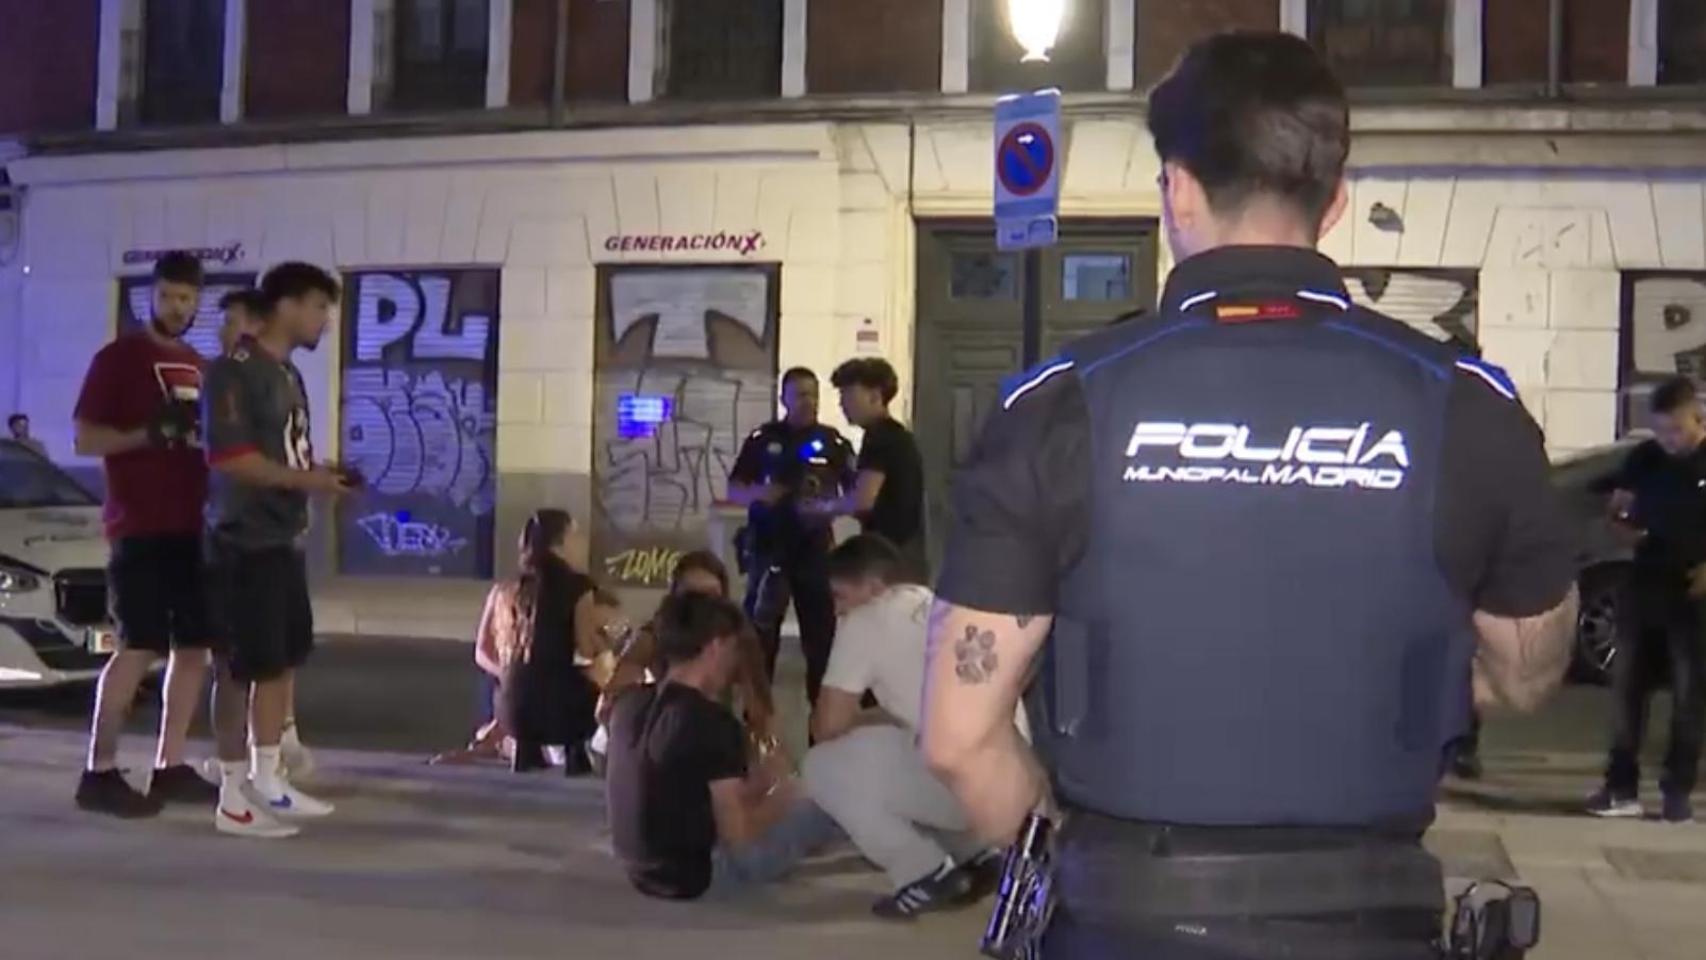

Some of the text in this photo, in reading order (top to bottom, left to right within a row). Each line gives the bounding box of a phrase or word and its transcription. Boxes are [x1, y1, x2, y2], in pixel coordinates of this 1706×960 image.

[1125, 421, 1410, 468] POLICÍA
[1122, 463, 1404, 490] MUNICIPAL MADRID
